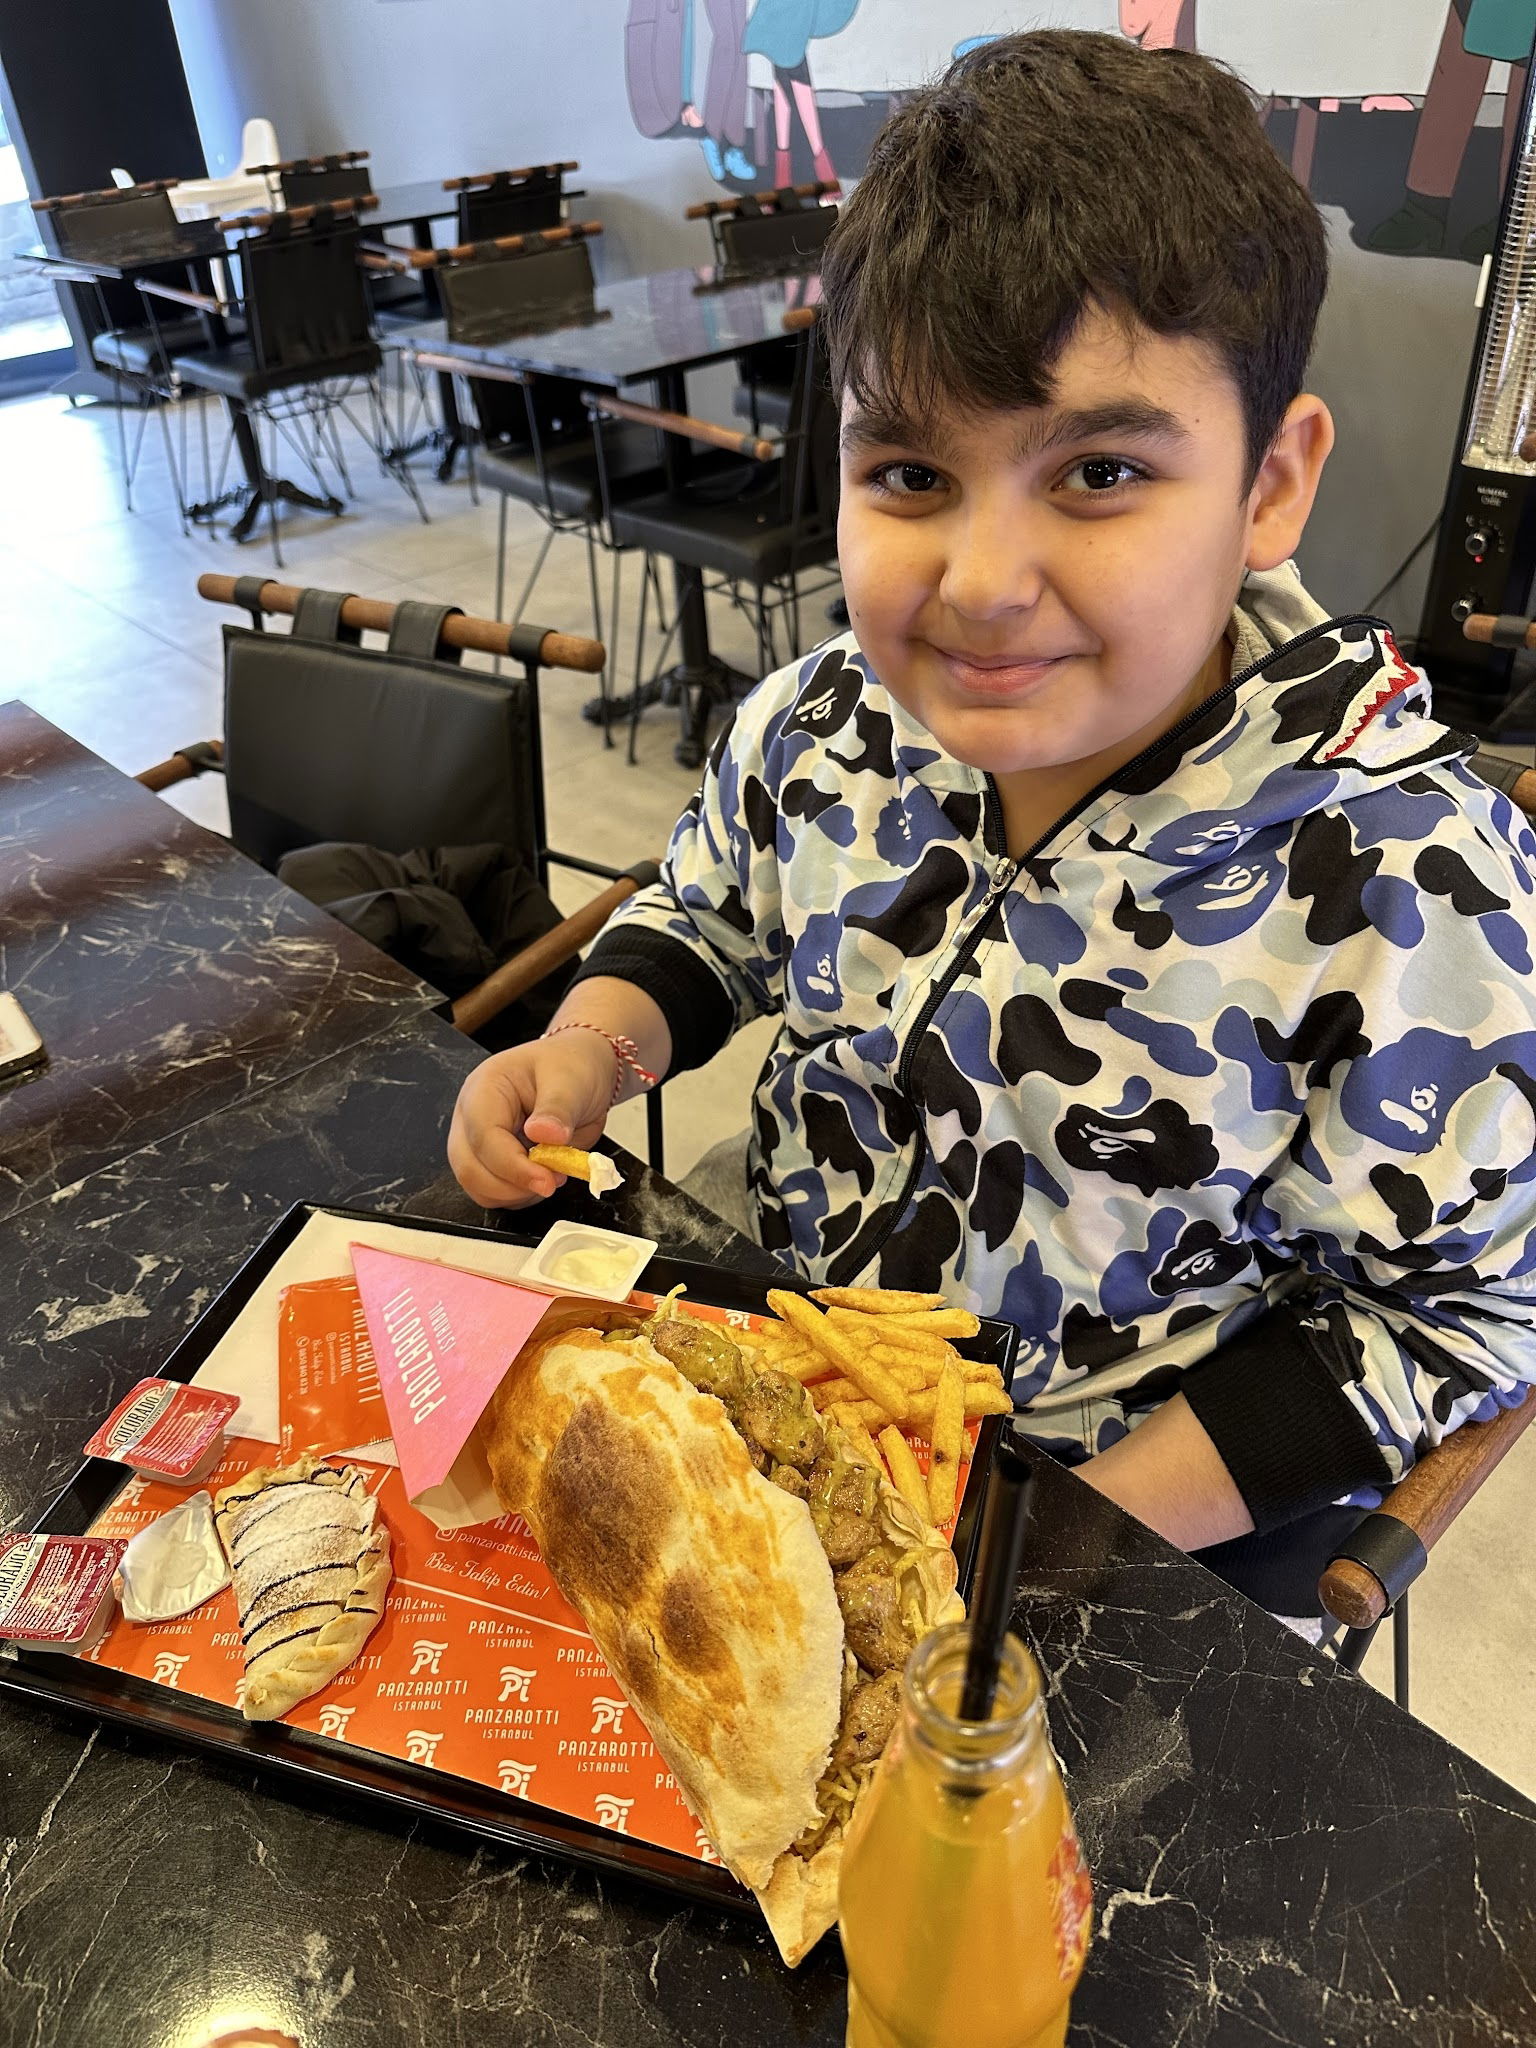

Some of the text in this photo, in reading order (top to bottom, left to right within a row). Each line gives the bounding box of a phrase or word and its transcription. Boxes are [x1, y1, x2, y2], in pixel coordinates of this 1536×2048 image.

[427, 1300, 457, 1355] ISTANBUL
[382, 1287, 447, 1425] PANZAROTTI
[113, 1394, 160, 1444] COLORADO
[424, 1551, 551, 1600] Bizi Takip Edin!
[400, 1612, 448, 1624] ISTANBUL
[146, 1625, 194, 1635] ISTANBUL
[485, 1638, 535, 1649] ISTANBUL
[376, 1679, 468, 1698] PANZAROTTI
[393, 1700, 443, 1712] ISTANBUL
[464, 1708, 560, 1725] PANZAROTTI
[482, 1728, 535, 1740] ISTANBUL
[557, 1740, 655, 1758] PANZAROTTI
[577, 1761, 630, 1774] ISTANBUL
